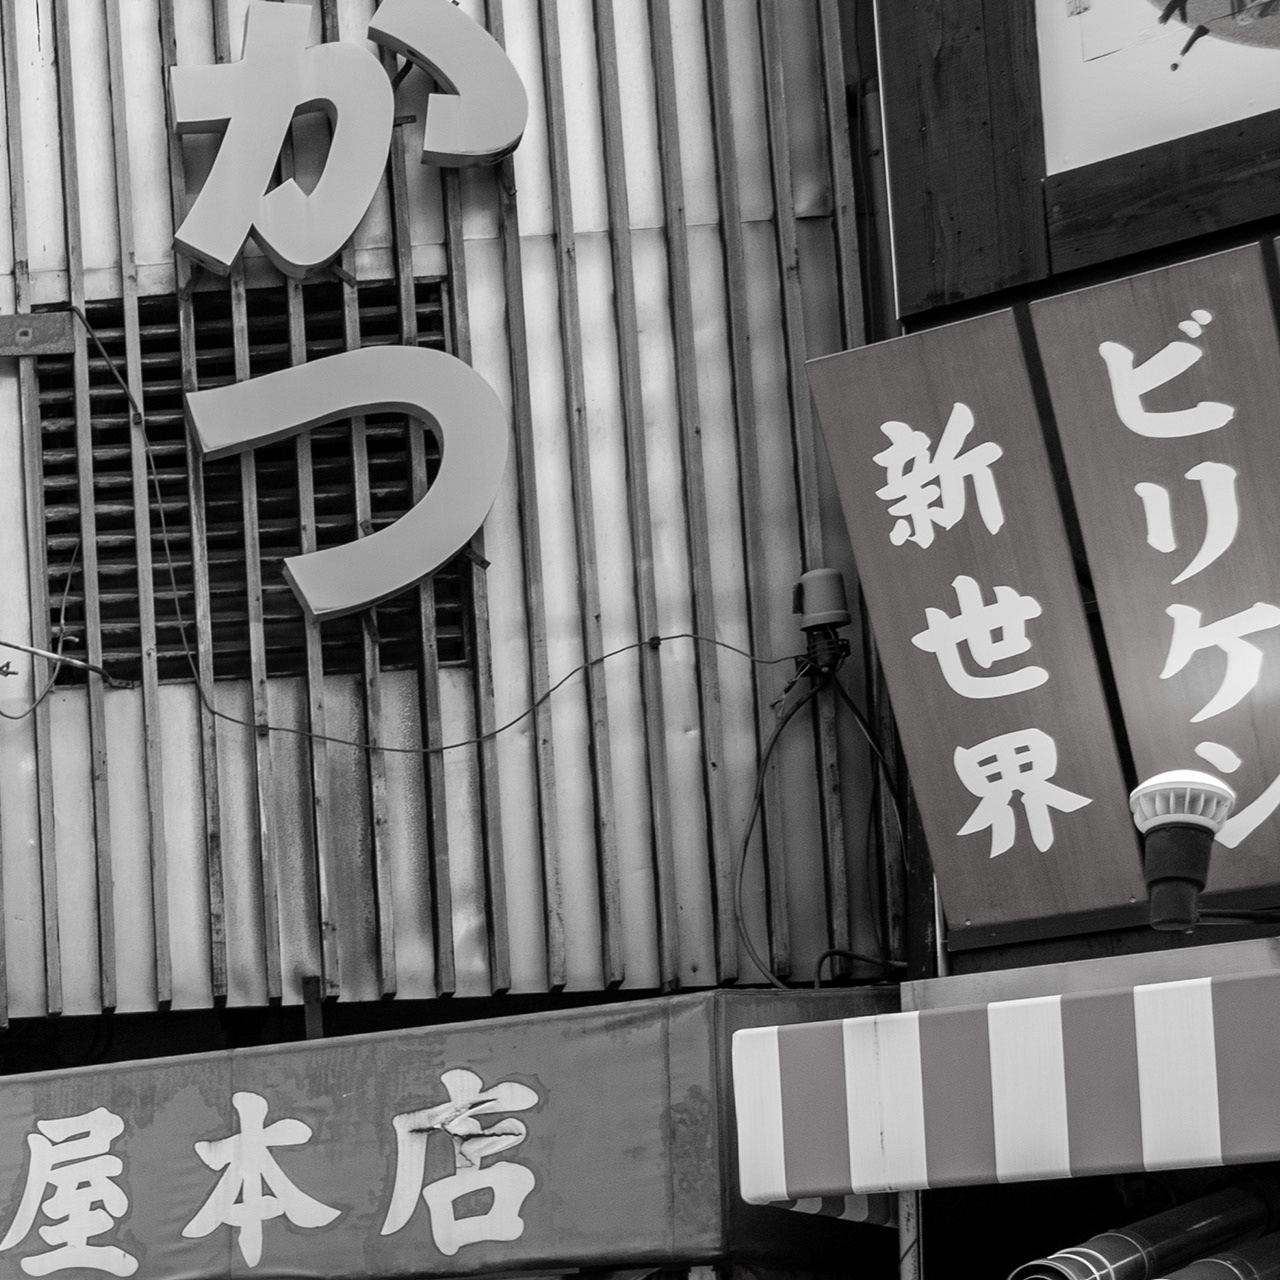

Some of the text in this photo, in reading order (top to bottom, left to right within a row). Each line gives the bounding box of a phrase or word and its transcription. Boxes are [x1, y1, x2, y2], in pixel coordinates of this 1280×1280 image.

[171, 0, 528, 620] かつ
[876, 403, 1093, 859] 新世界
